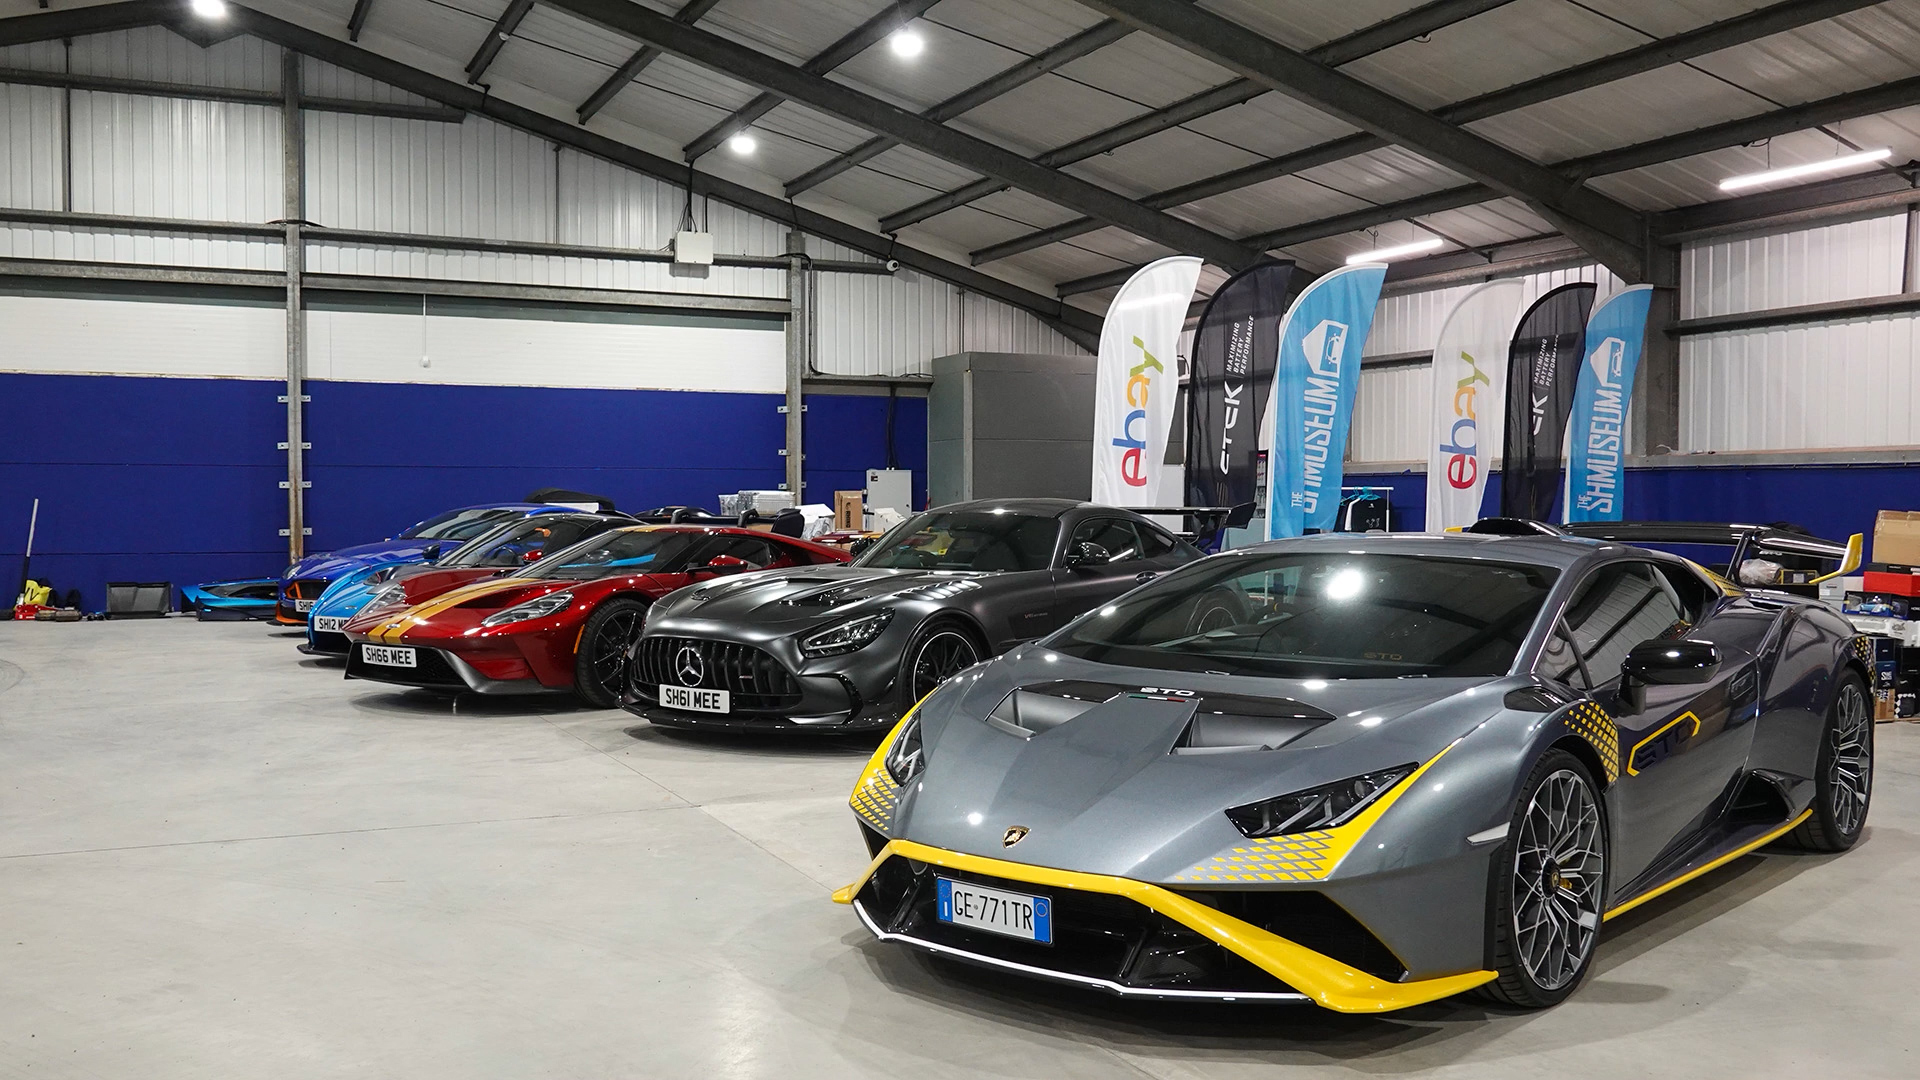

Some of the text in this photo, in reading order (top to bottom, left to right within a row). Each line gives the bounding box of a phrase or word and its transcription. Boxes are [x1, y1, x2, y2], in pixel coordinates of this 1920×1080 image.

[1226, 322, 1240, 372] MAXIMIZING
[1233, 338, 1244, 374] BATTERY
[1240, 315, 1254, 375] PERFORMANCE
[1533, 338, 1548, 384] MAXIMIZING
[1538, 352, 1551, 385] BATTERY
[1112, 335, 1164, 487] ebay
[1440, 351, 1490, 489] ebay
[1586, 389, 1622, 513] SHMUSEUM
[1291, 491, 1303, 508] THE
[1576, 494, 1590, 509] THE
[319, 618, 336, 630] SH12
[366, 647, 412, 665] SH66 MEE
[666, 688, 721, 710] SH61 MEE
[1140, 687, 1195, 697] STO
